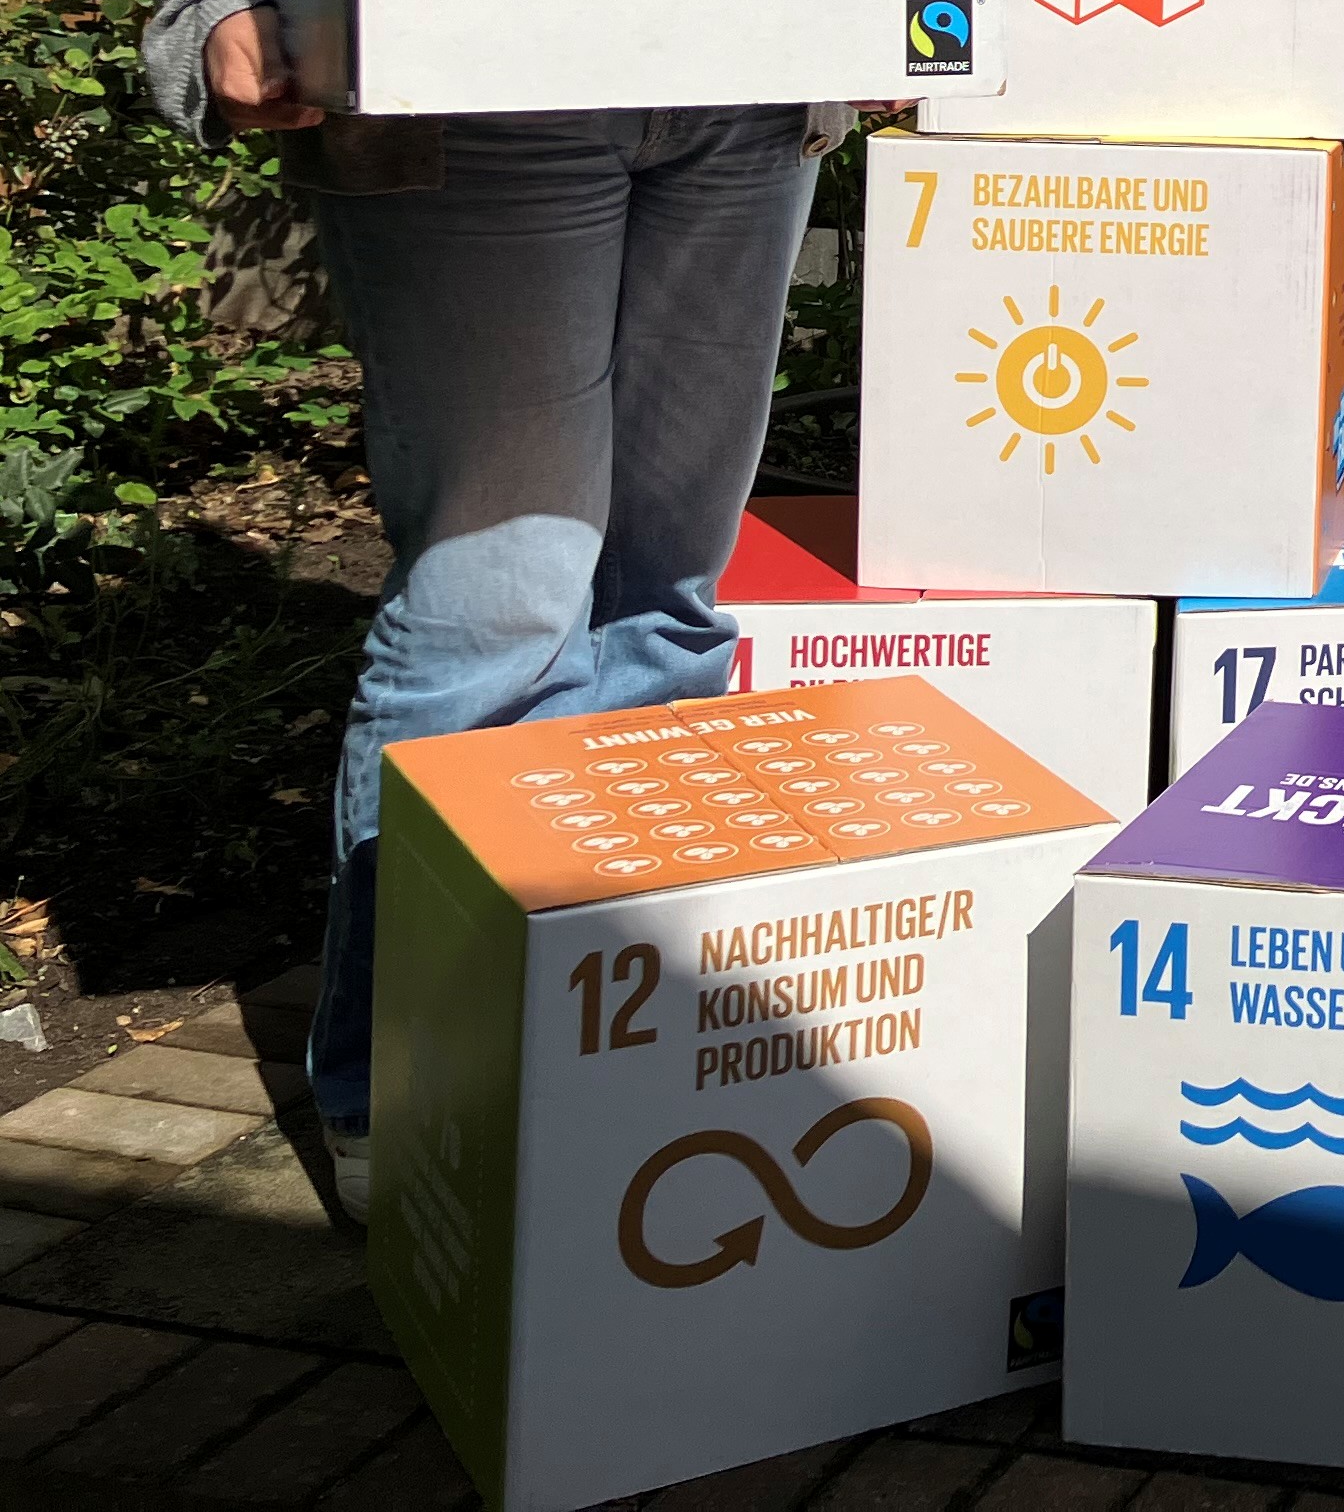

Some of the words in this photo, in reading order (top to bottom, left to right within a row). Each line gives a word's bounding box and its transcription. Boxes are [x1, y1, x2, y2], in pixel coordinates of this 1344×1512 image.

[909, 61, 971, 73] FAIRTRADE
[904, 171, 938, 248] 7
[973, 173, 1147, 212] BEZAHLBARE
[1153, 179, 1208, 212] UND
[971, 217, 1094, 253] SAUBERE
[1100, 221, 1210, 257] ENERGIE
[791, 633, 991, 668] HOCHWERTIGE
[1213, 646, 1276, 724] 17
[582, 719, 736, 751] GEWINNT
[739, 708, 816, 727] VIER
[700, 889, 973, 976] NACHHALTIGE/R
[1230, 925, 1334, 974] LEBEN
[568, 942, 660, 1056] 12
[697, 964, 846, 1034] KONSUM
[856, 953, 924, 1003] UND
[1109, 920, 1193, 1020] 14
[695, 1008, 920, 1091] PRODUKTION
